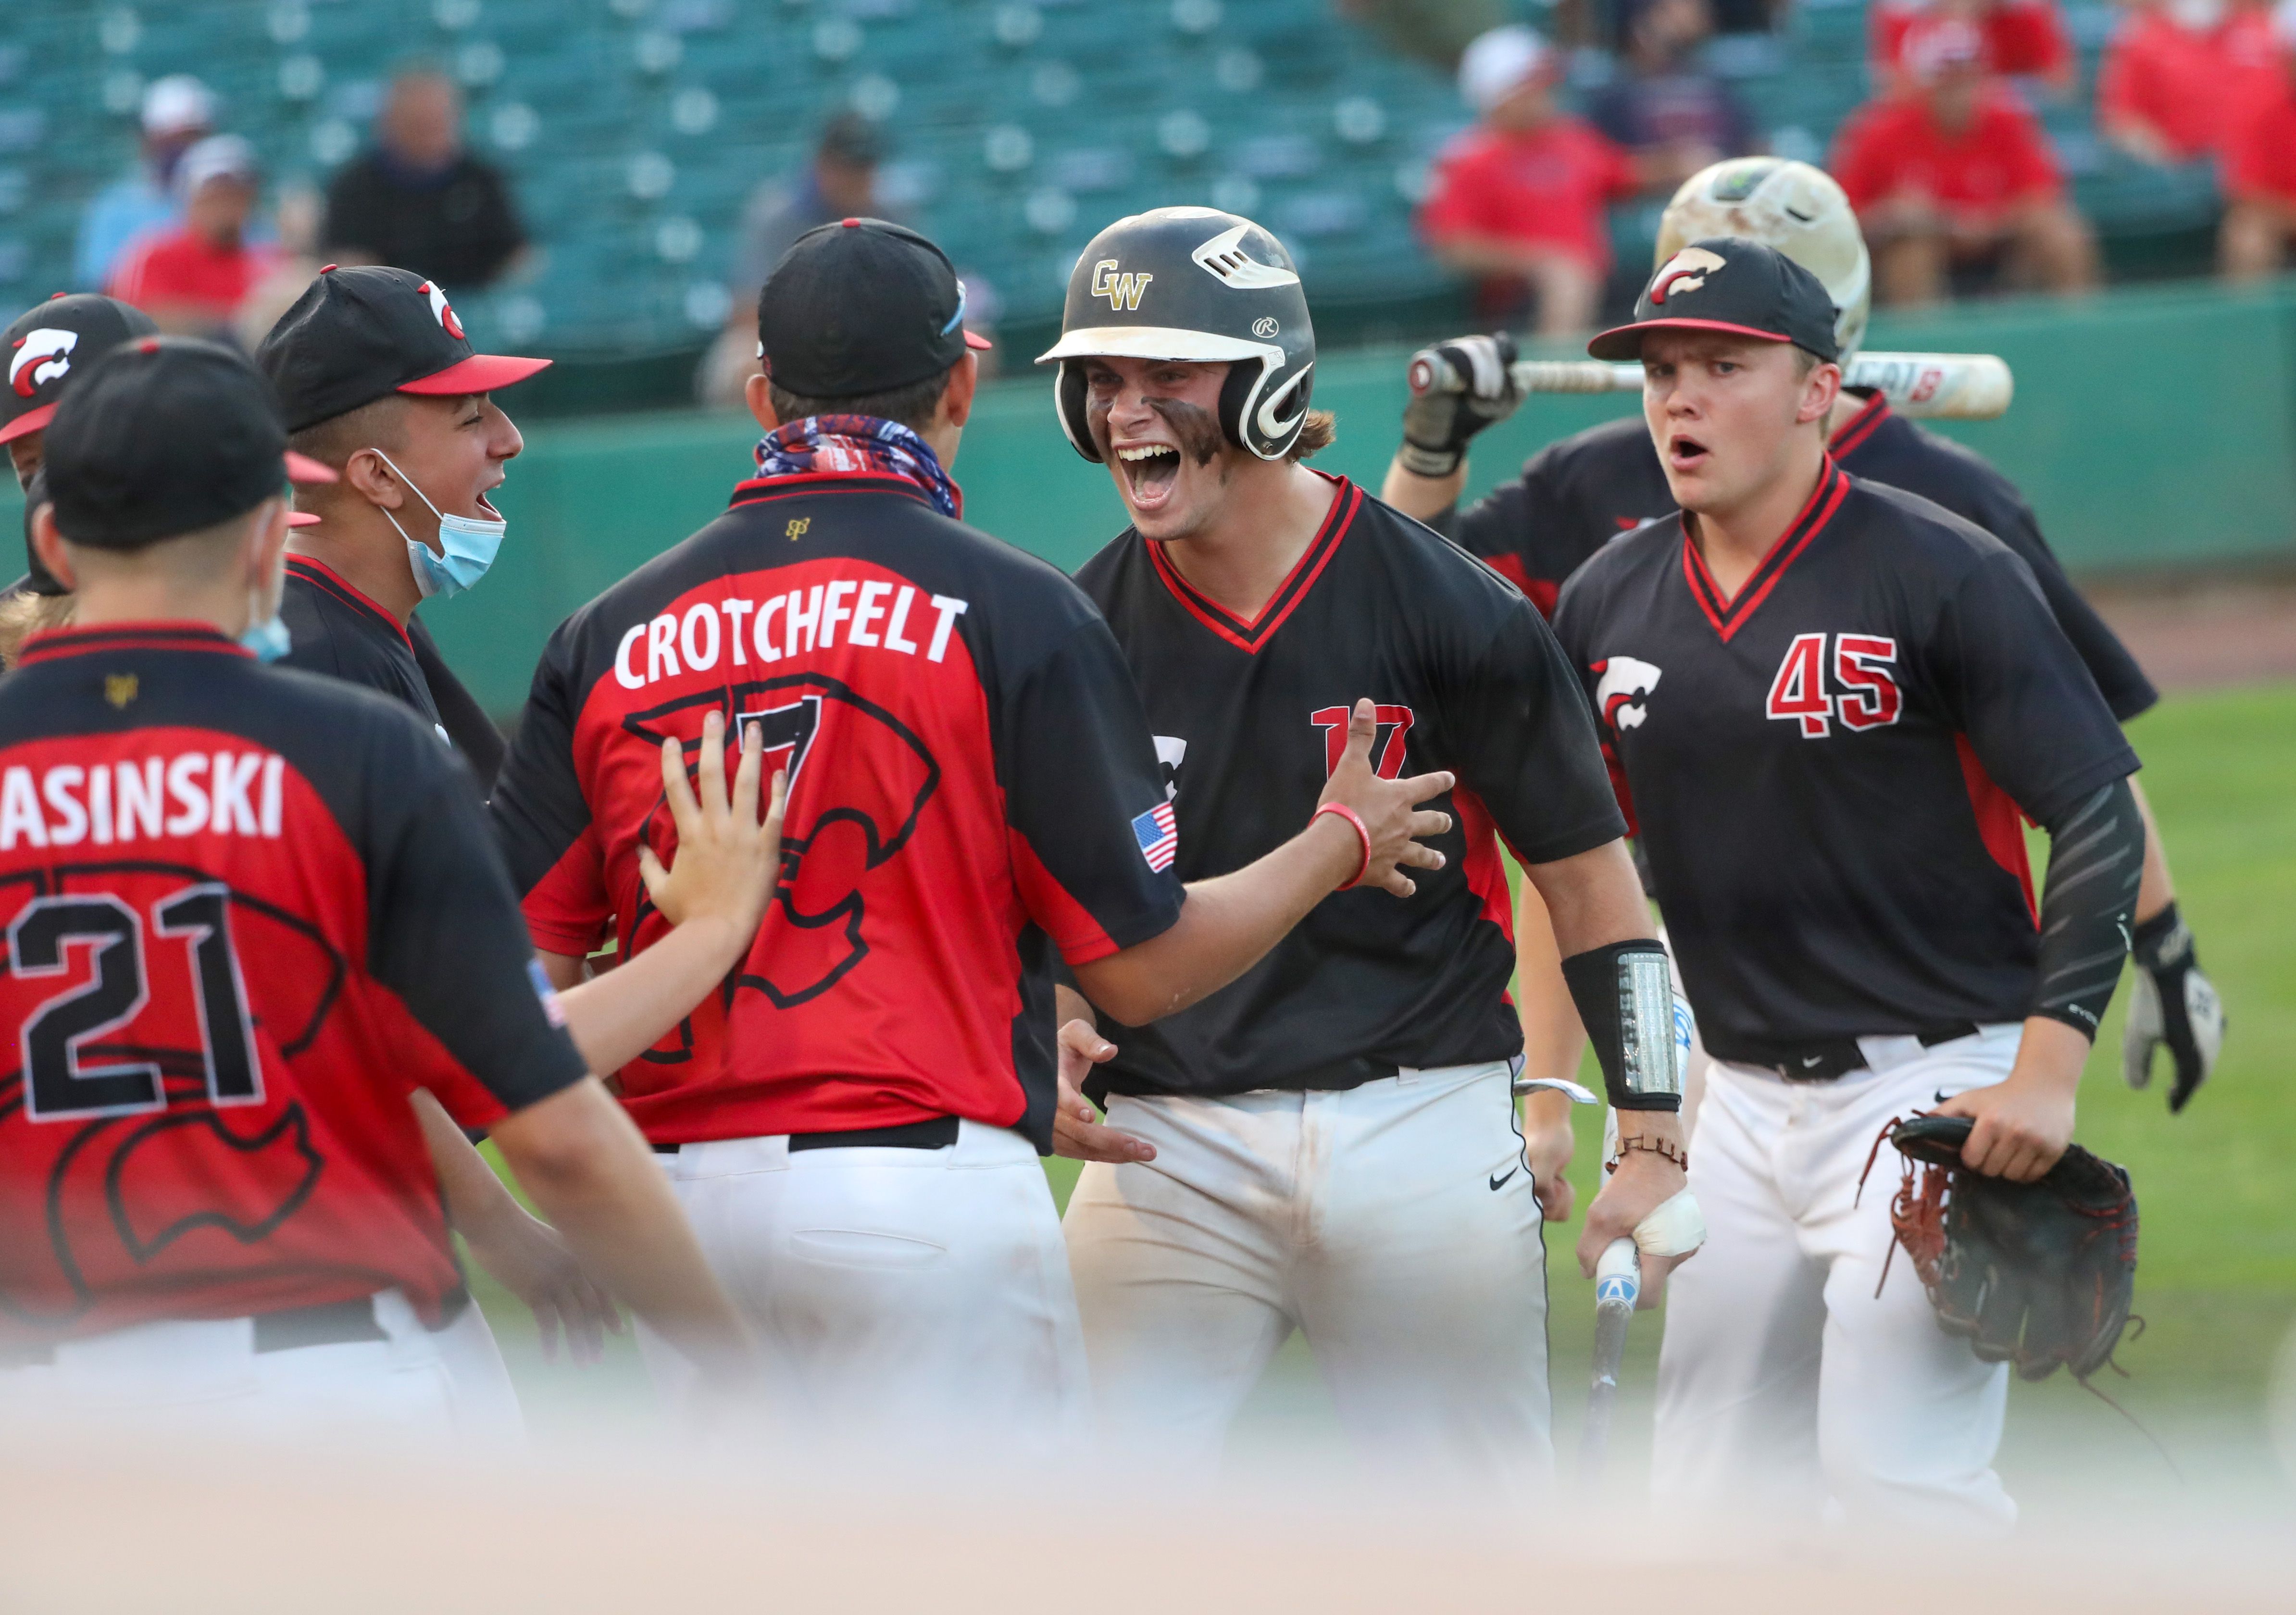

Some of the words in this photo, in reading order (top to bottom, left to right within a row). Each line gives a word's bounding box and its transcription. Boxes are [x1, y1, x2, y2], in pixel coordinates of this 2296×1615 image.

[1091, 259, 1153, 311] GW
[614, 580, 968, 690] CROTCHFELT
[1766, 632, 1903, 739] 45
[1310, 704, 1414, 781] 17
[0, 750, 285, 851] ASINSKI
[7, 881, 265, 1122] 21
